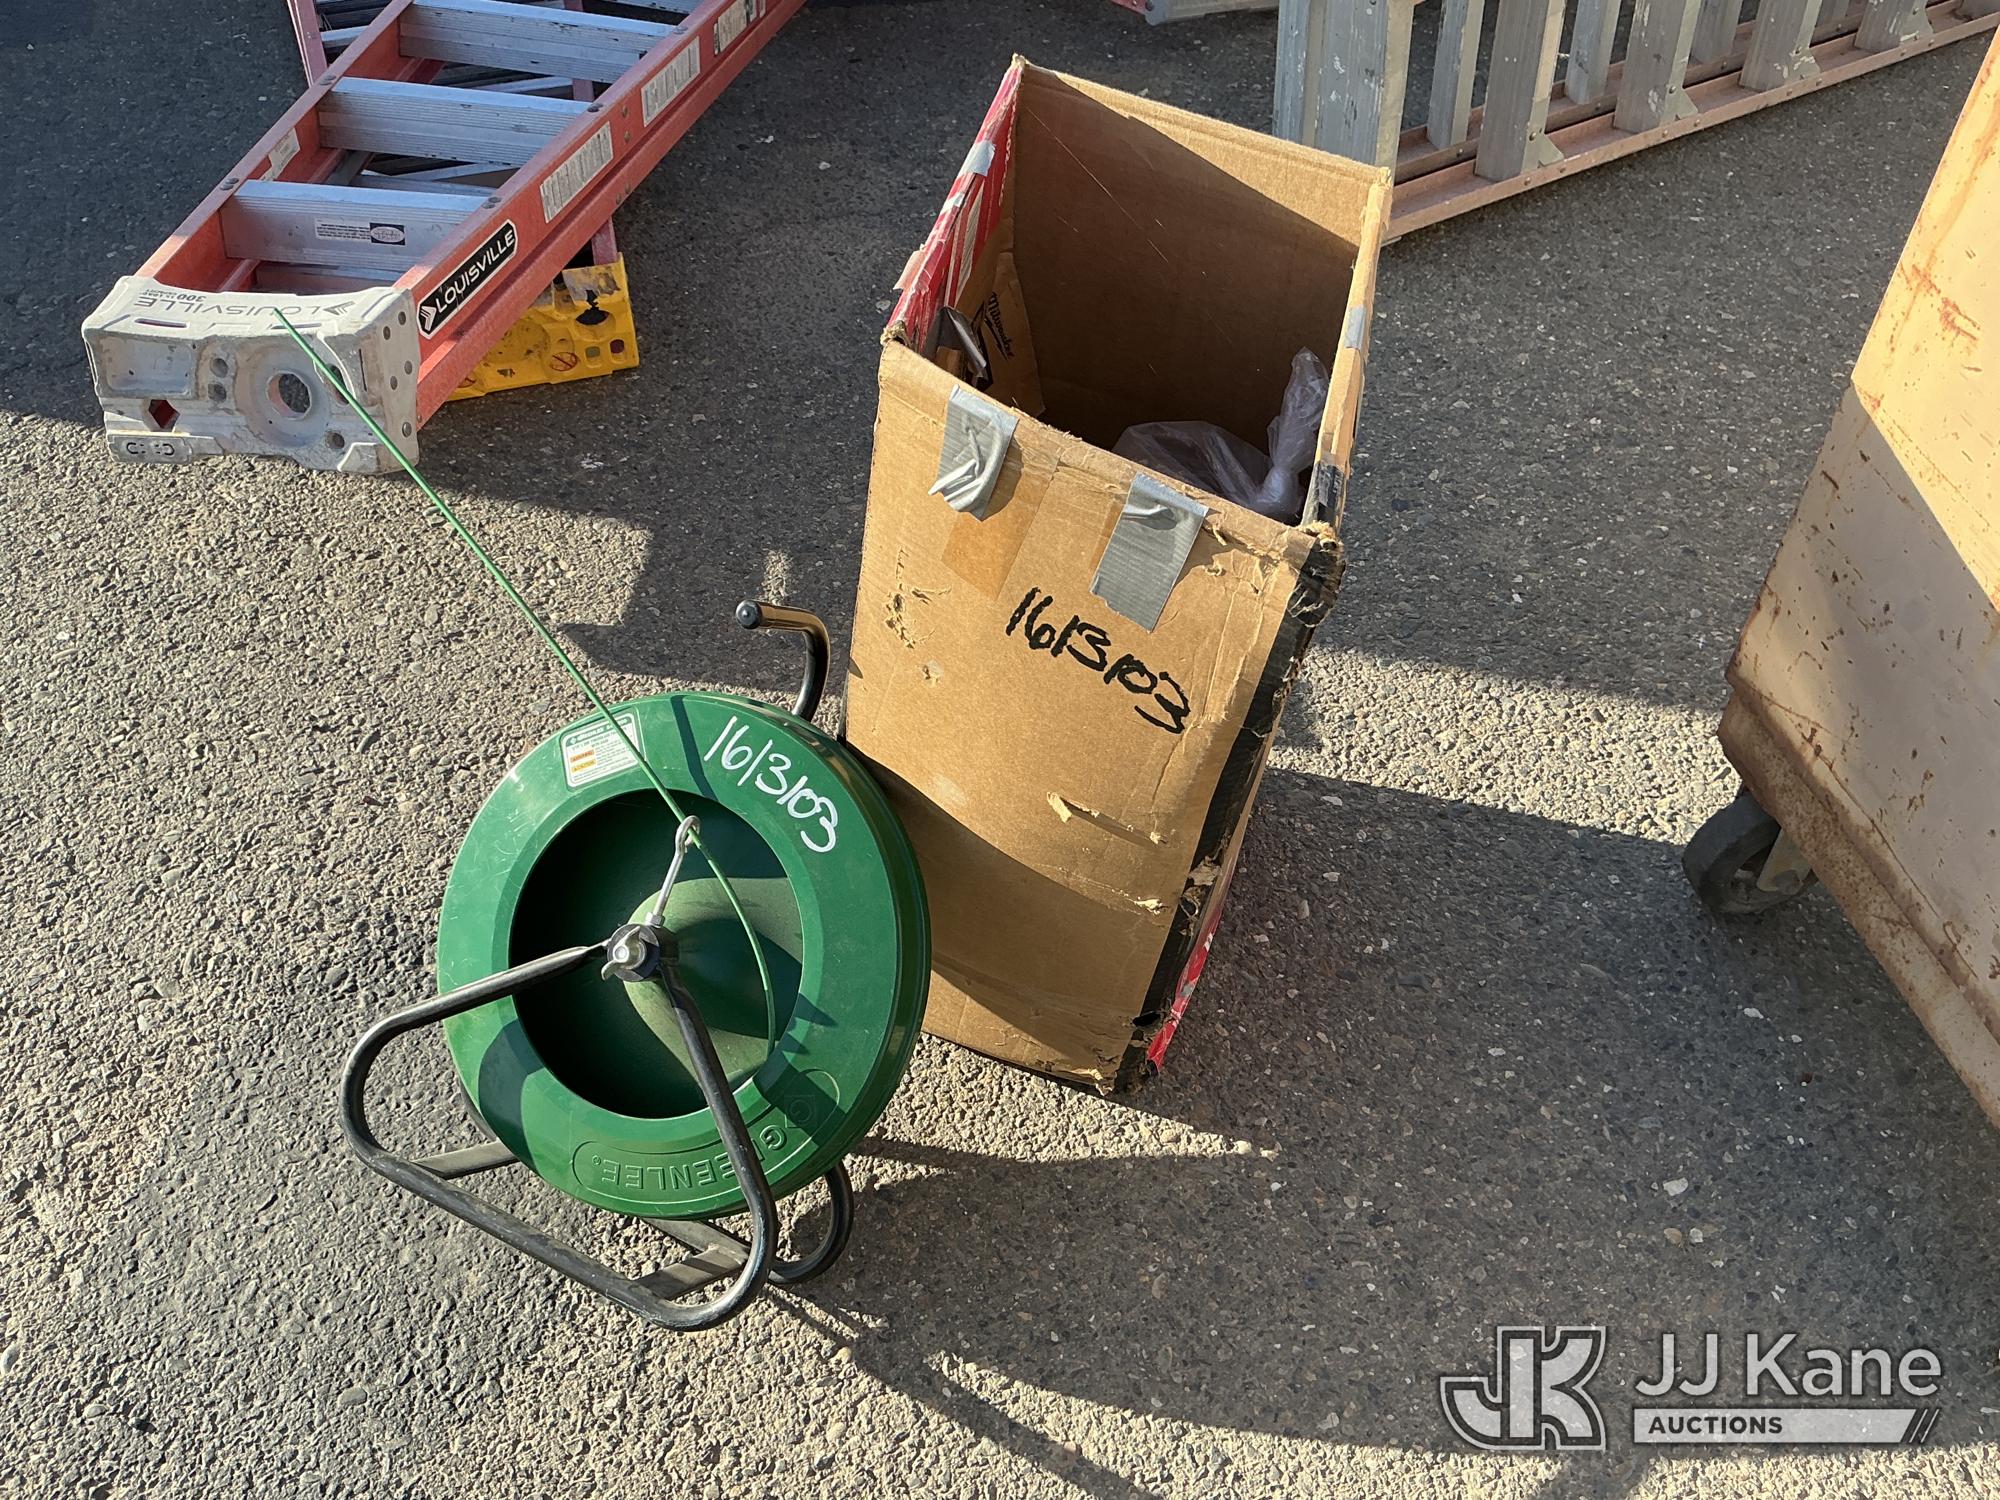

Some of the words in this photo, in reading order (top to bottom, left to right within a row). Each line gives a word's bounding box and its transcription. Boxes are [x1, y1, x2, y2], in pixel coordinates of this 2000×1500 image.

[435, 229, 515, 313] LOUISVILLE
[133, 296, 321, 316] LOUISVILLE
[601, 1124, 788, 1191] GEENLEE
